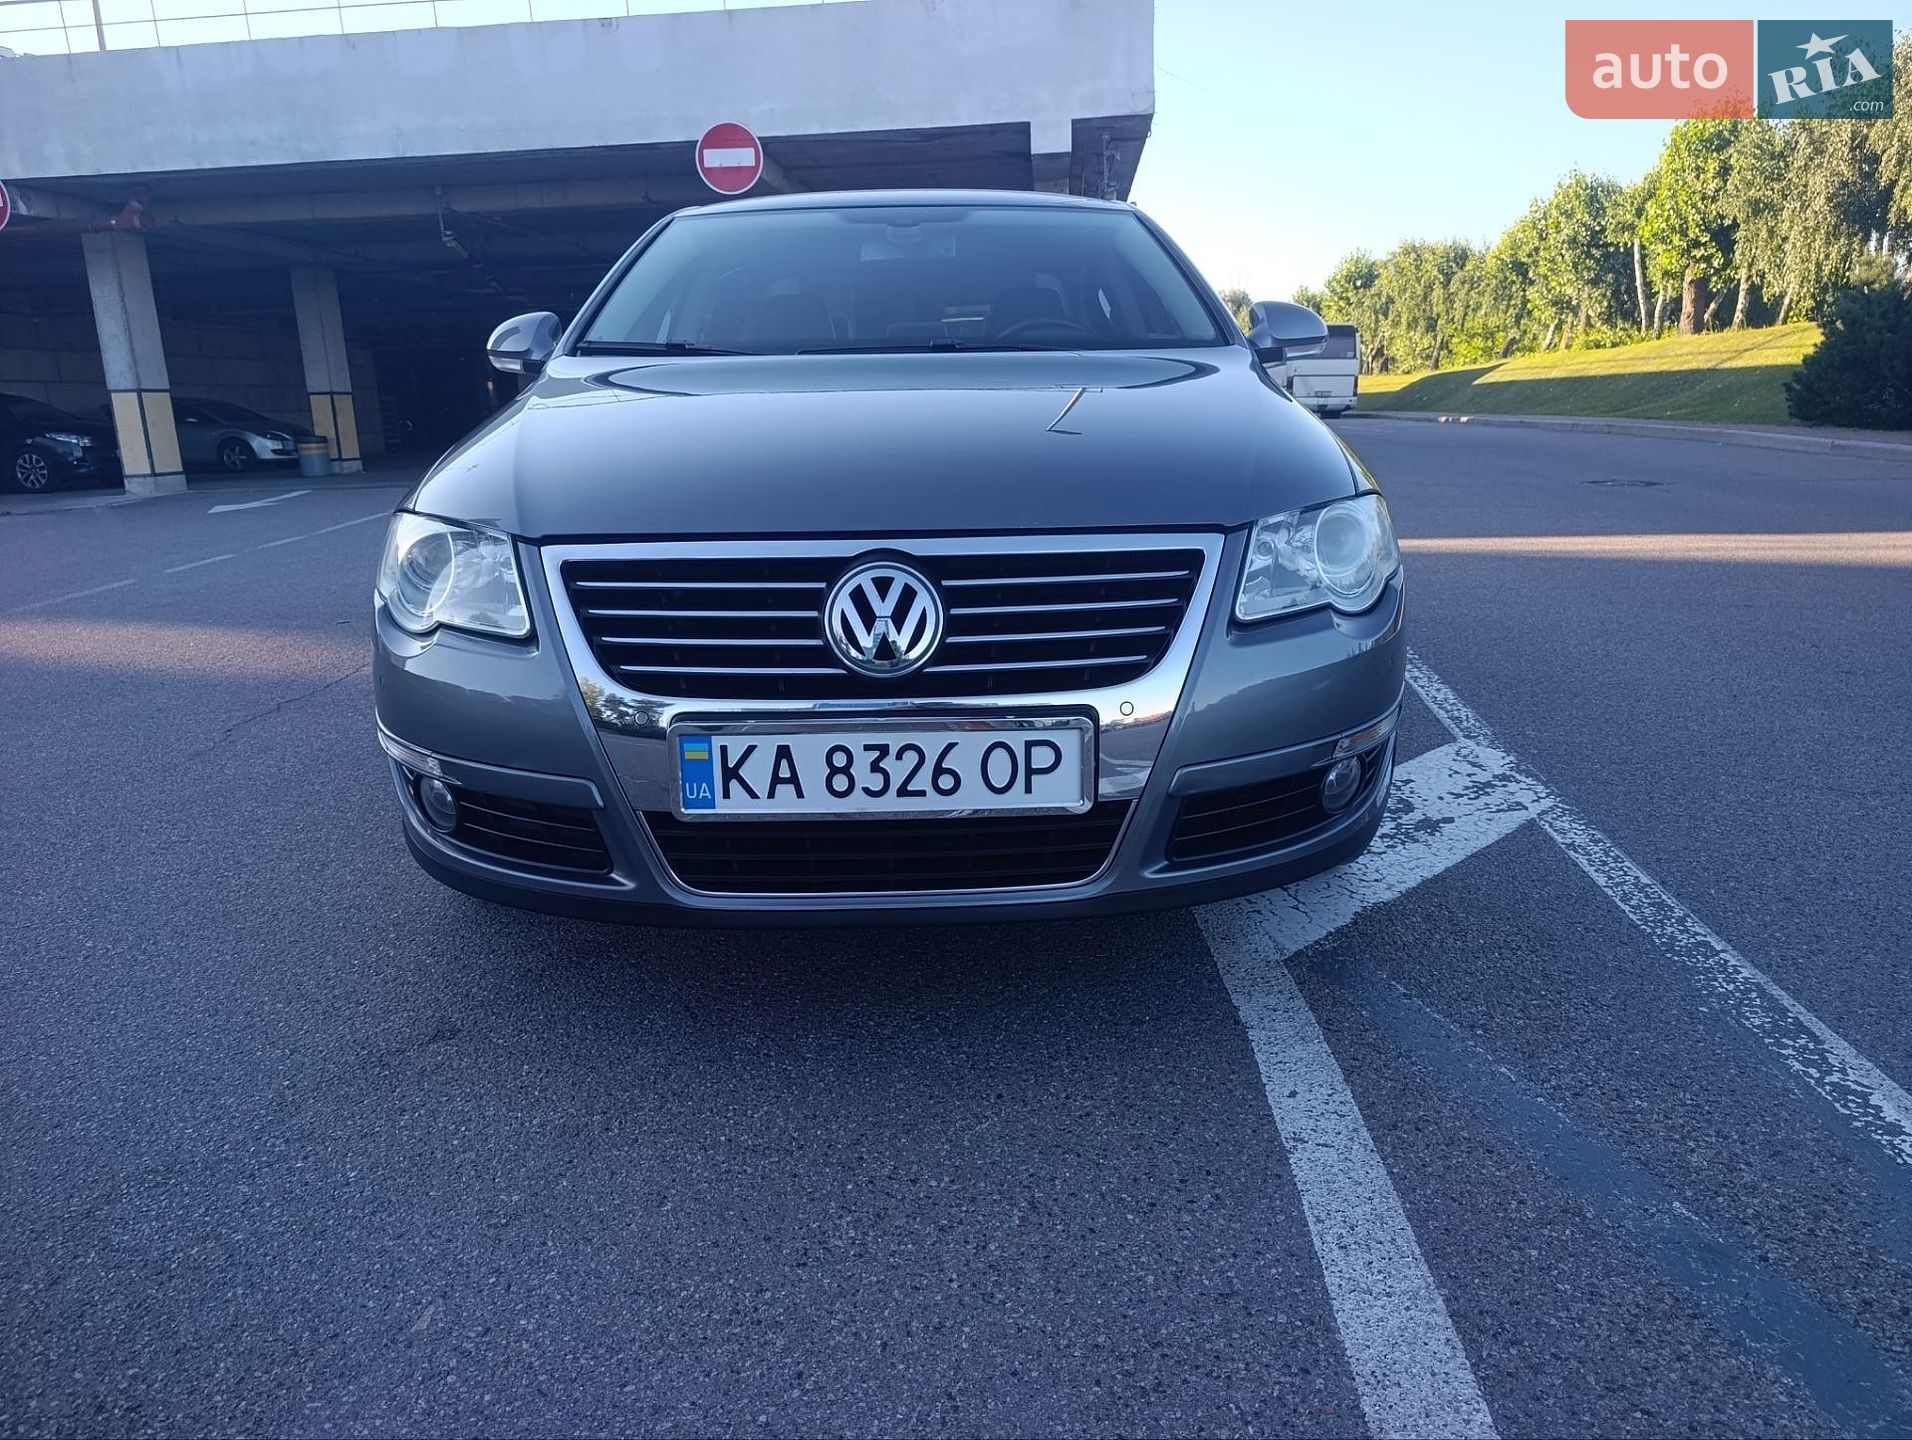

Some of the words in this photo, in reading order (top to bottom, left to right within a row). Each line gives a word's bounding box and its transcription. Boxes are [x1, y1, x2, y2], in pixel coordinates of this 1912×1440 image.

[719, 744, 805, 800] KA
[824, 742, 962, 799] 8326
[980, 739, 1062, 795] OP
[685, 782, 711, 800] UA
